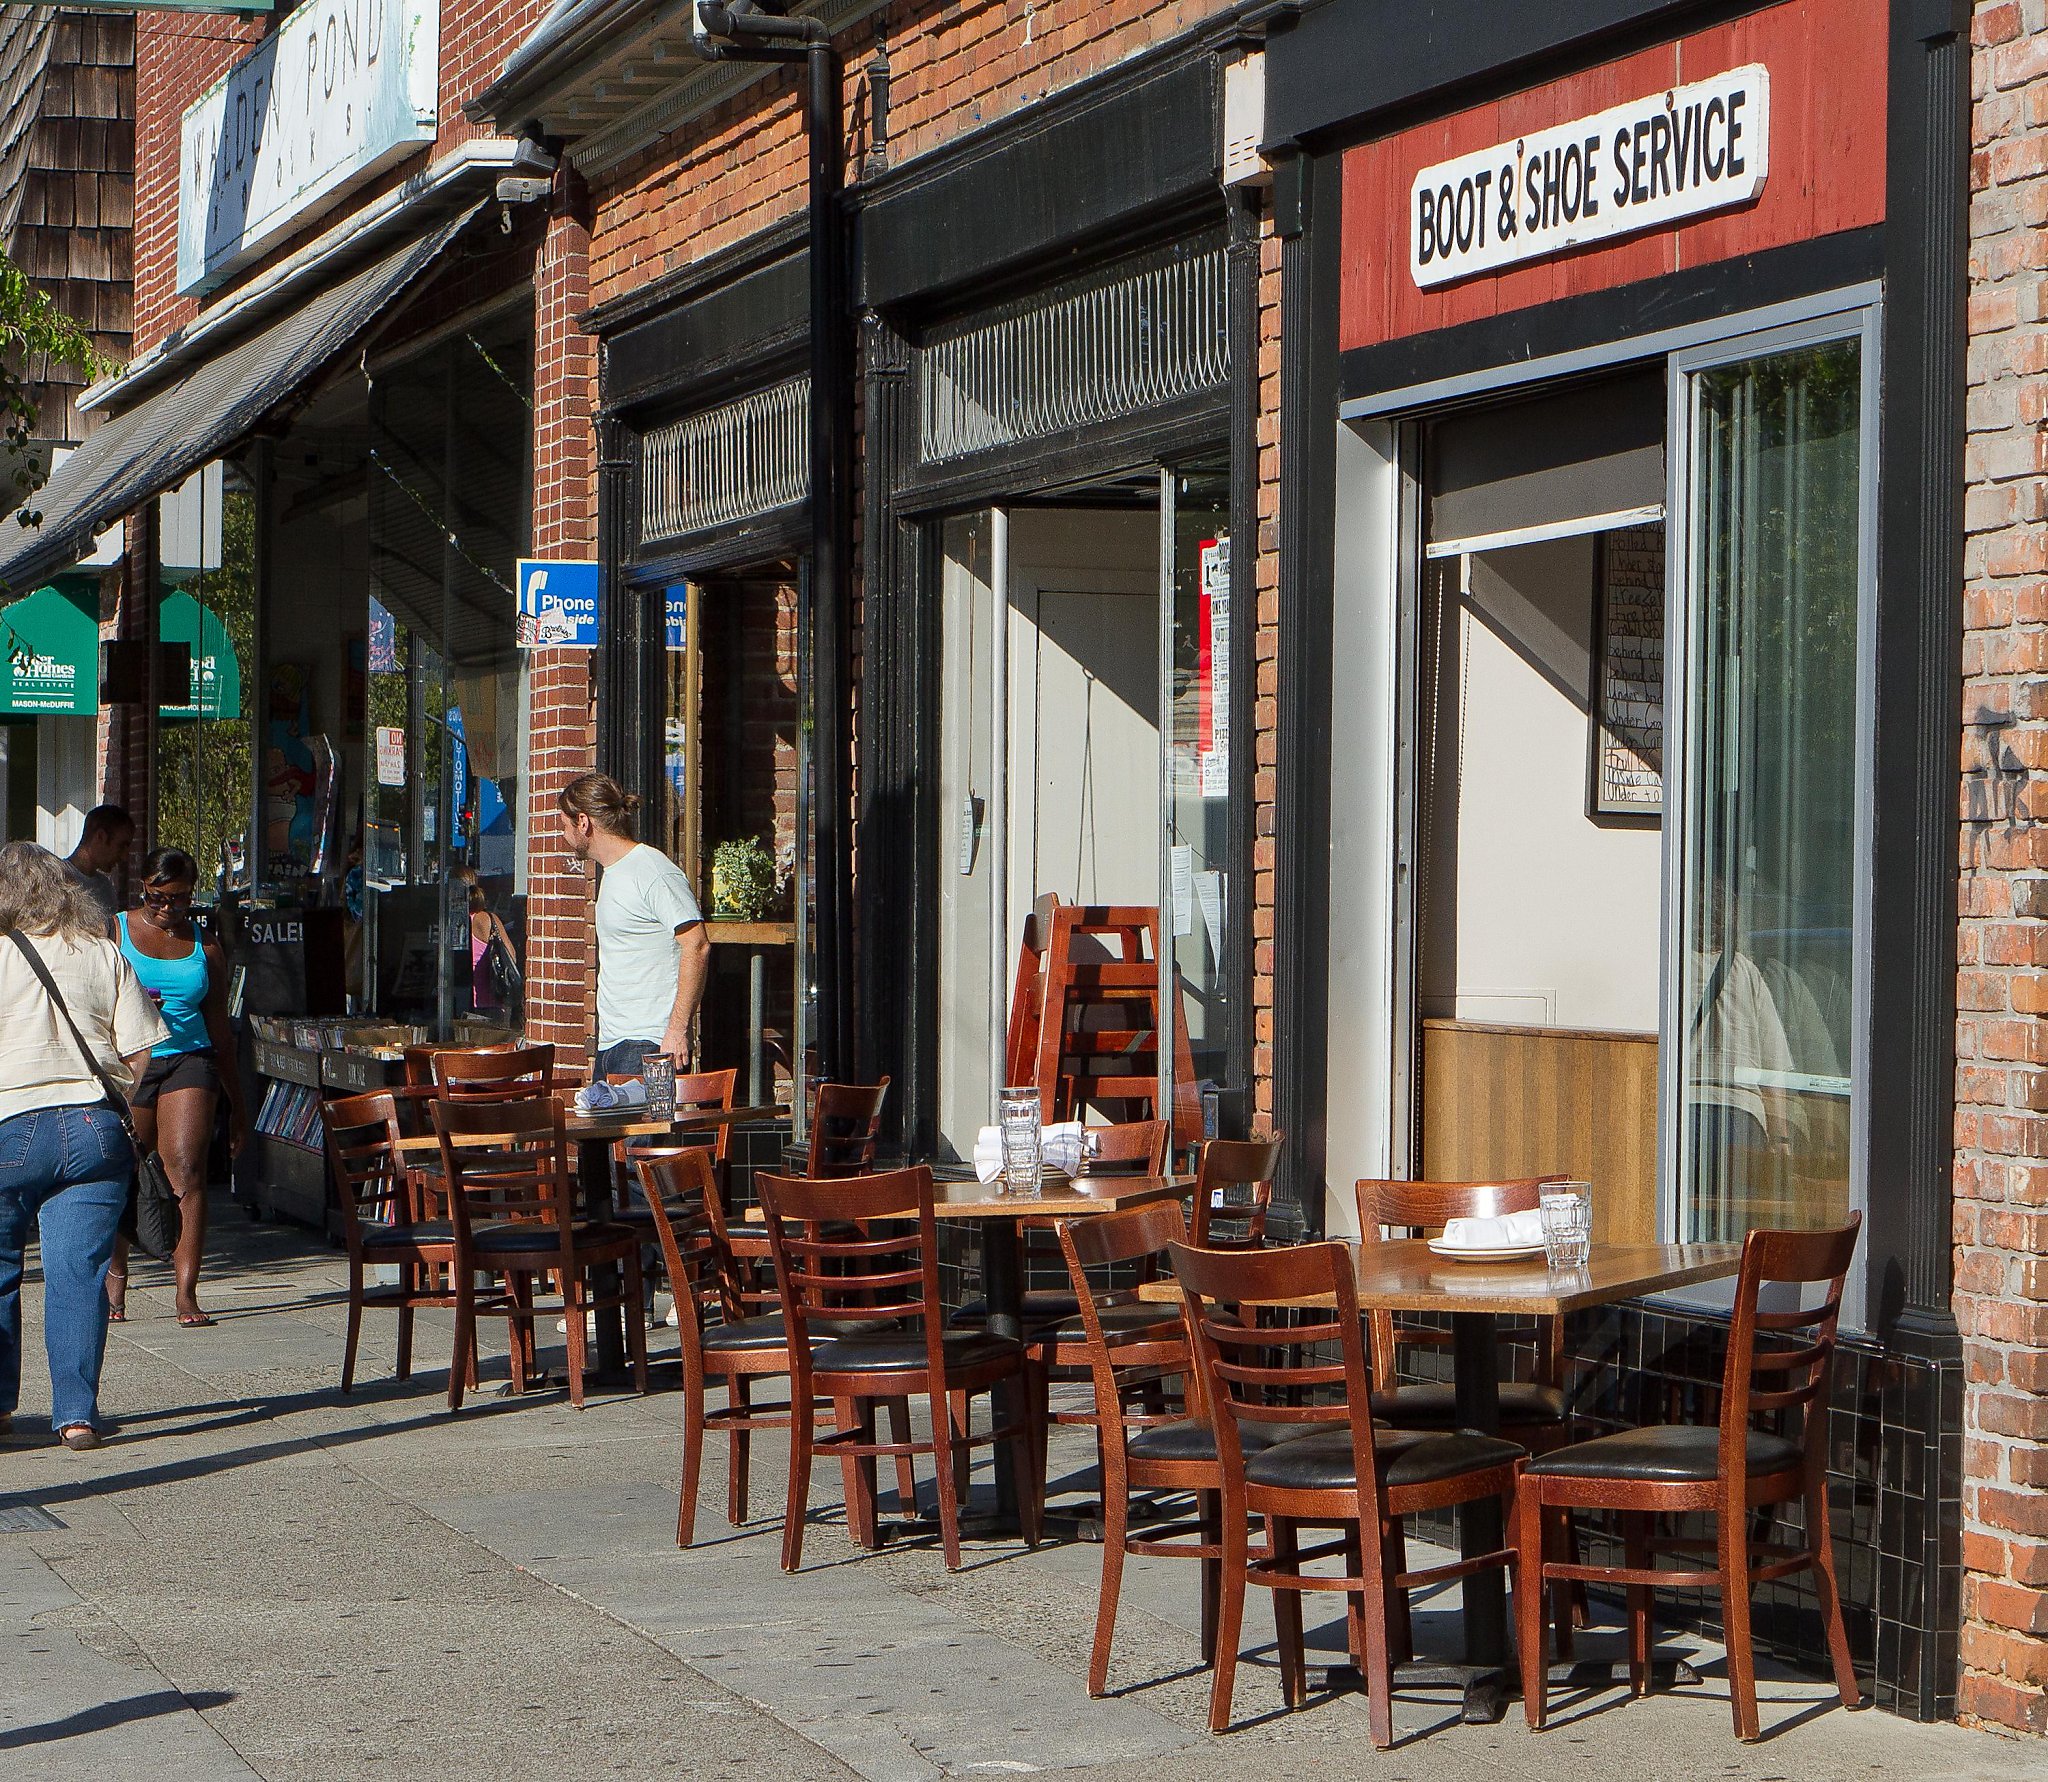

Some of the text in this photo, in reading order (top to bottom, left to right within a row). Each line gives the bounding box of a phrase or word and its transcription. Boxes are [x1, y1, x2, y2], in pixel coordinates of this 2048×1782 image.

[193, 0, 383, 202] WALDEN POND
[1419, 89, 1746, 265] BOOT & SHOE SERVICE
[542, 594, 595, 611] Phone
[566, 615, 595, 625] side
[25, 664, 75, 678] Homes
[12, 700, 75, 709] MASON-McDUFFIE
[251, 921, 304, 943] SALE!
